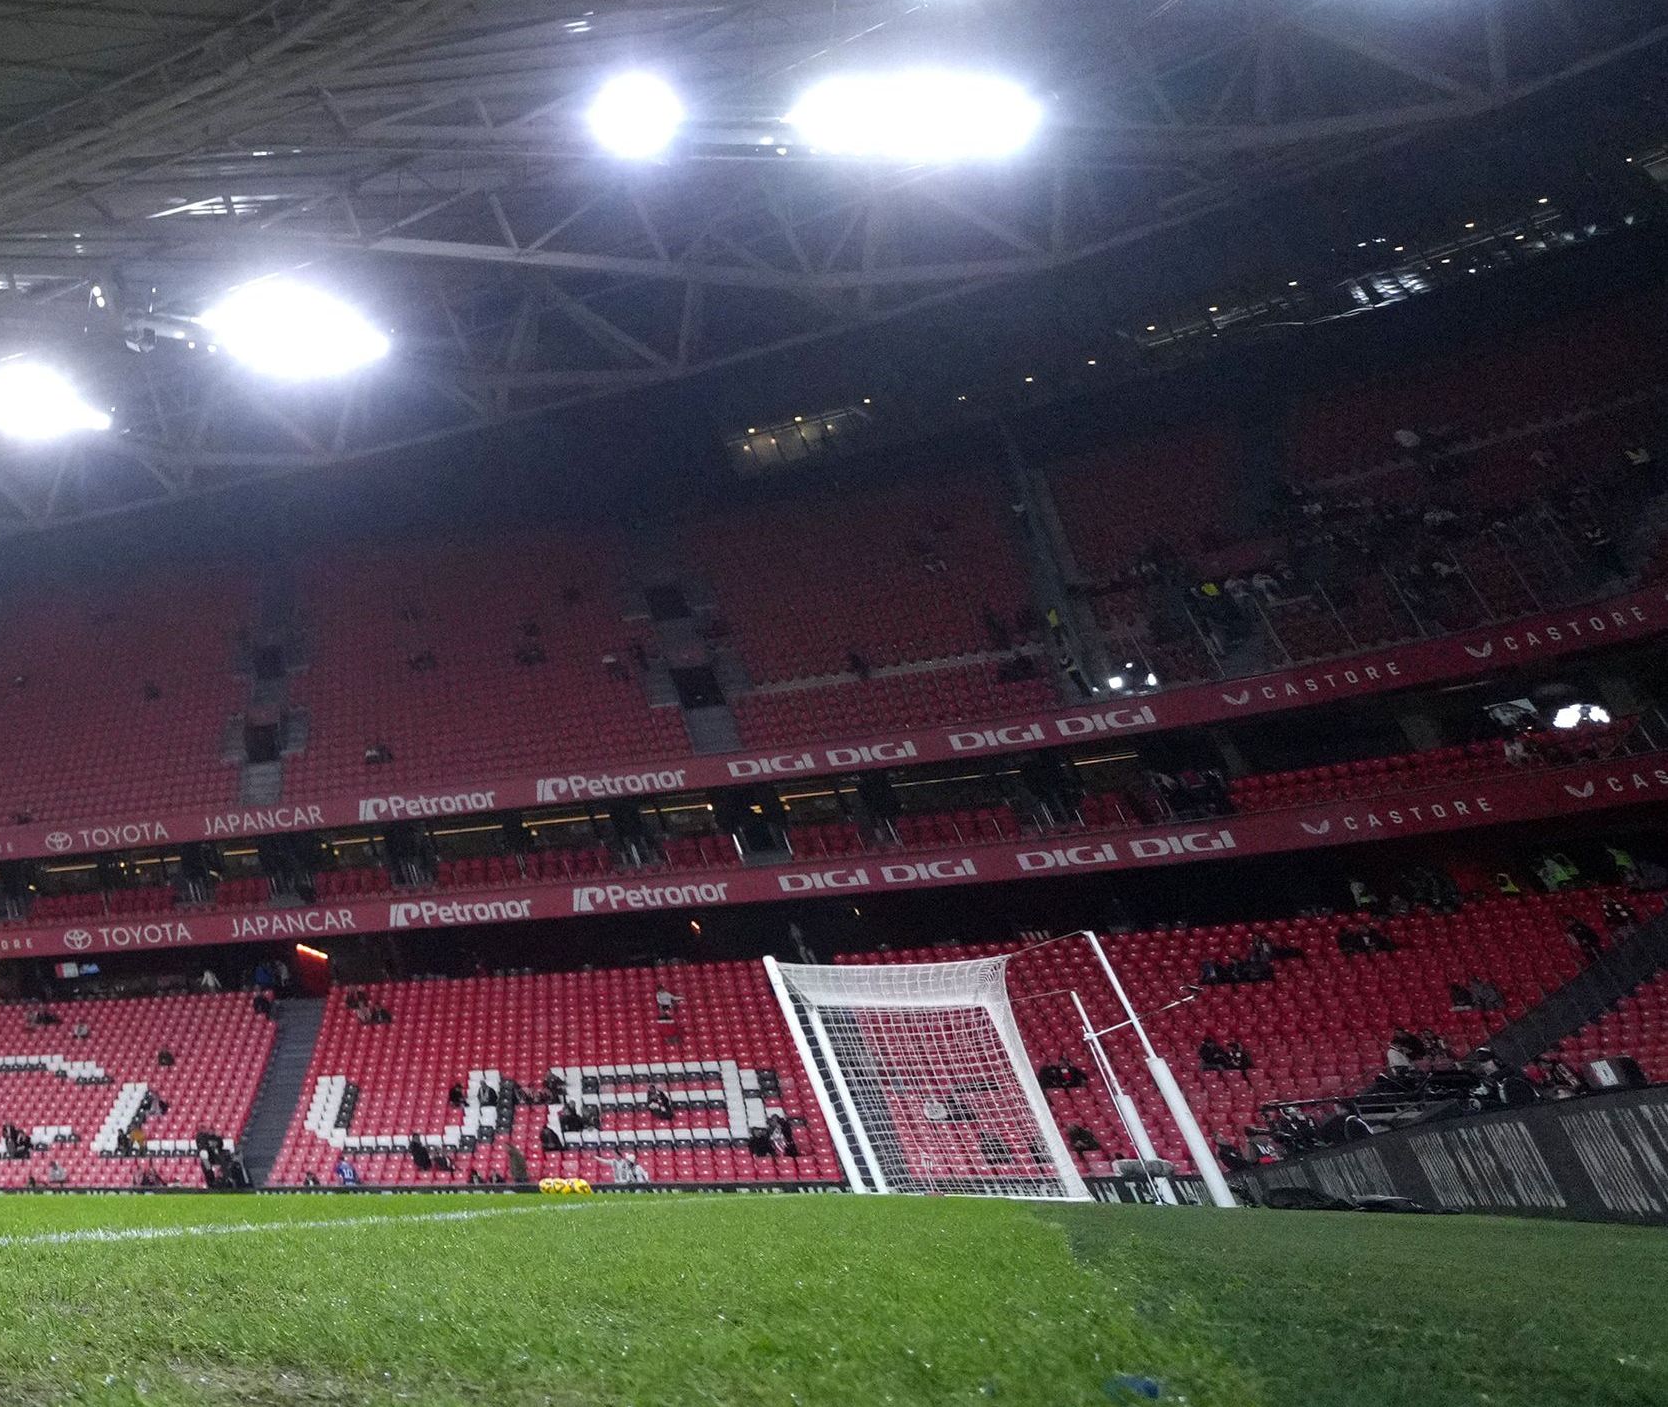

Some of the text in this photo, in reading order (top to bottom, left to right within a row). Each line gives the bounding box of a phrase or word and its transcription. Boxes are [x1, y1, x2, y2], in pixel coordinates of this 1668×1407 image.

[1504, 605, 1648, 652] CASTORE
[1262, 661, 1401, 700] CASTORE
[1056, 706, 1157, 736] DIGI
[948, 724, 1045, 752] DIGI
[727, 754, 815, 777] DIGI
[825, 741, 917, 768] DIGI
[567, 770, 686, 797] Petronor
[387, 791, 496, 819] Petronor
[1343, 796, 1493, 831] CASTORE
[79, 822, 169, 848] TOYOTA
[1129, 829, 1236, 859] DIGI
[880, 858, 978, 883] DIGI
[1016, 843, 1117, 871] DIGI
[777, 868, 869, 892] DIGI
[607, 882, 728, 910] Petronor
[420, 899, 533, 927] Petronor
[99, 922, 192, 947] TOYOTA
